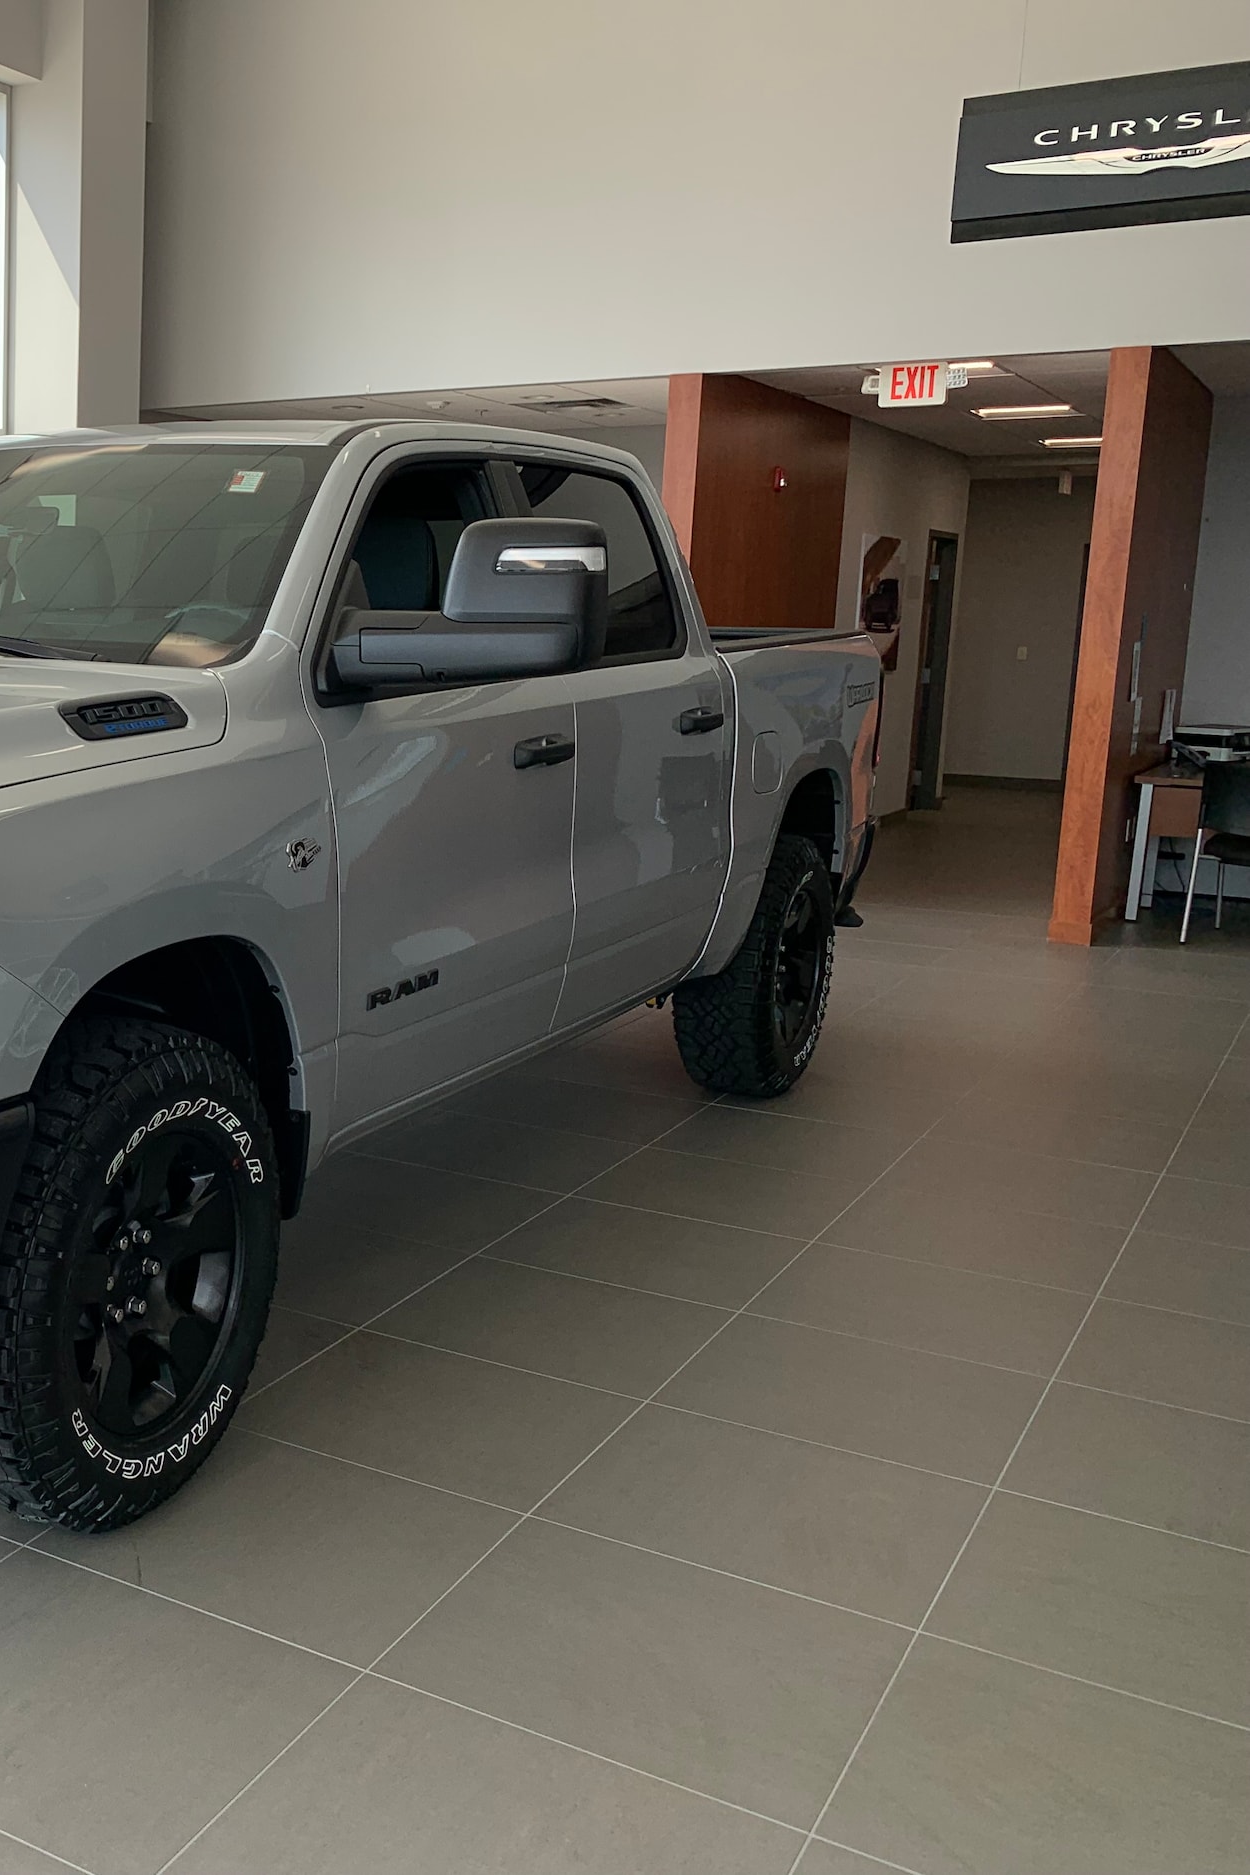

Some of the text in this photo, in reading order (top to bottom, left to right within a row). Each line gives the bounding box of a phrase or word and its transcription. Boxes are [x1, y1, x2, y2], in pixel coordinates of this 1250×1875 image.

[1034, 109, 1250, 146] CHRYSL
[1131, 148, 1206, 161] CHRYSLER
[891, 365, 939, 400] EXIT
[80, 700, 163, 725] 1500
[366, 968, 439, 1011] RAM
[106, 1098, 263, 1184] GOODYEAR
[72, 1384, 232, 1479] WRANGLER
